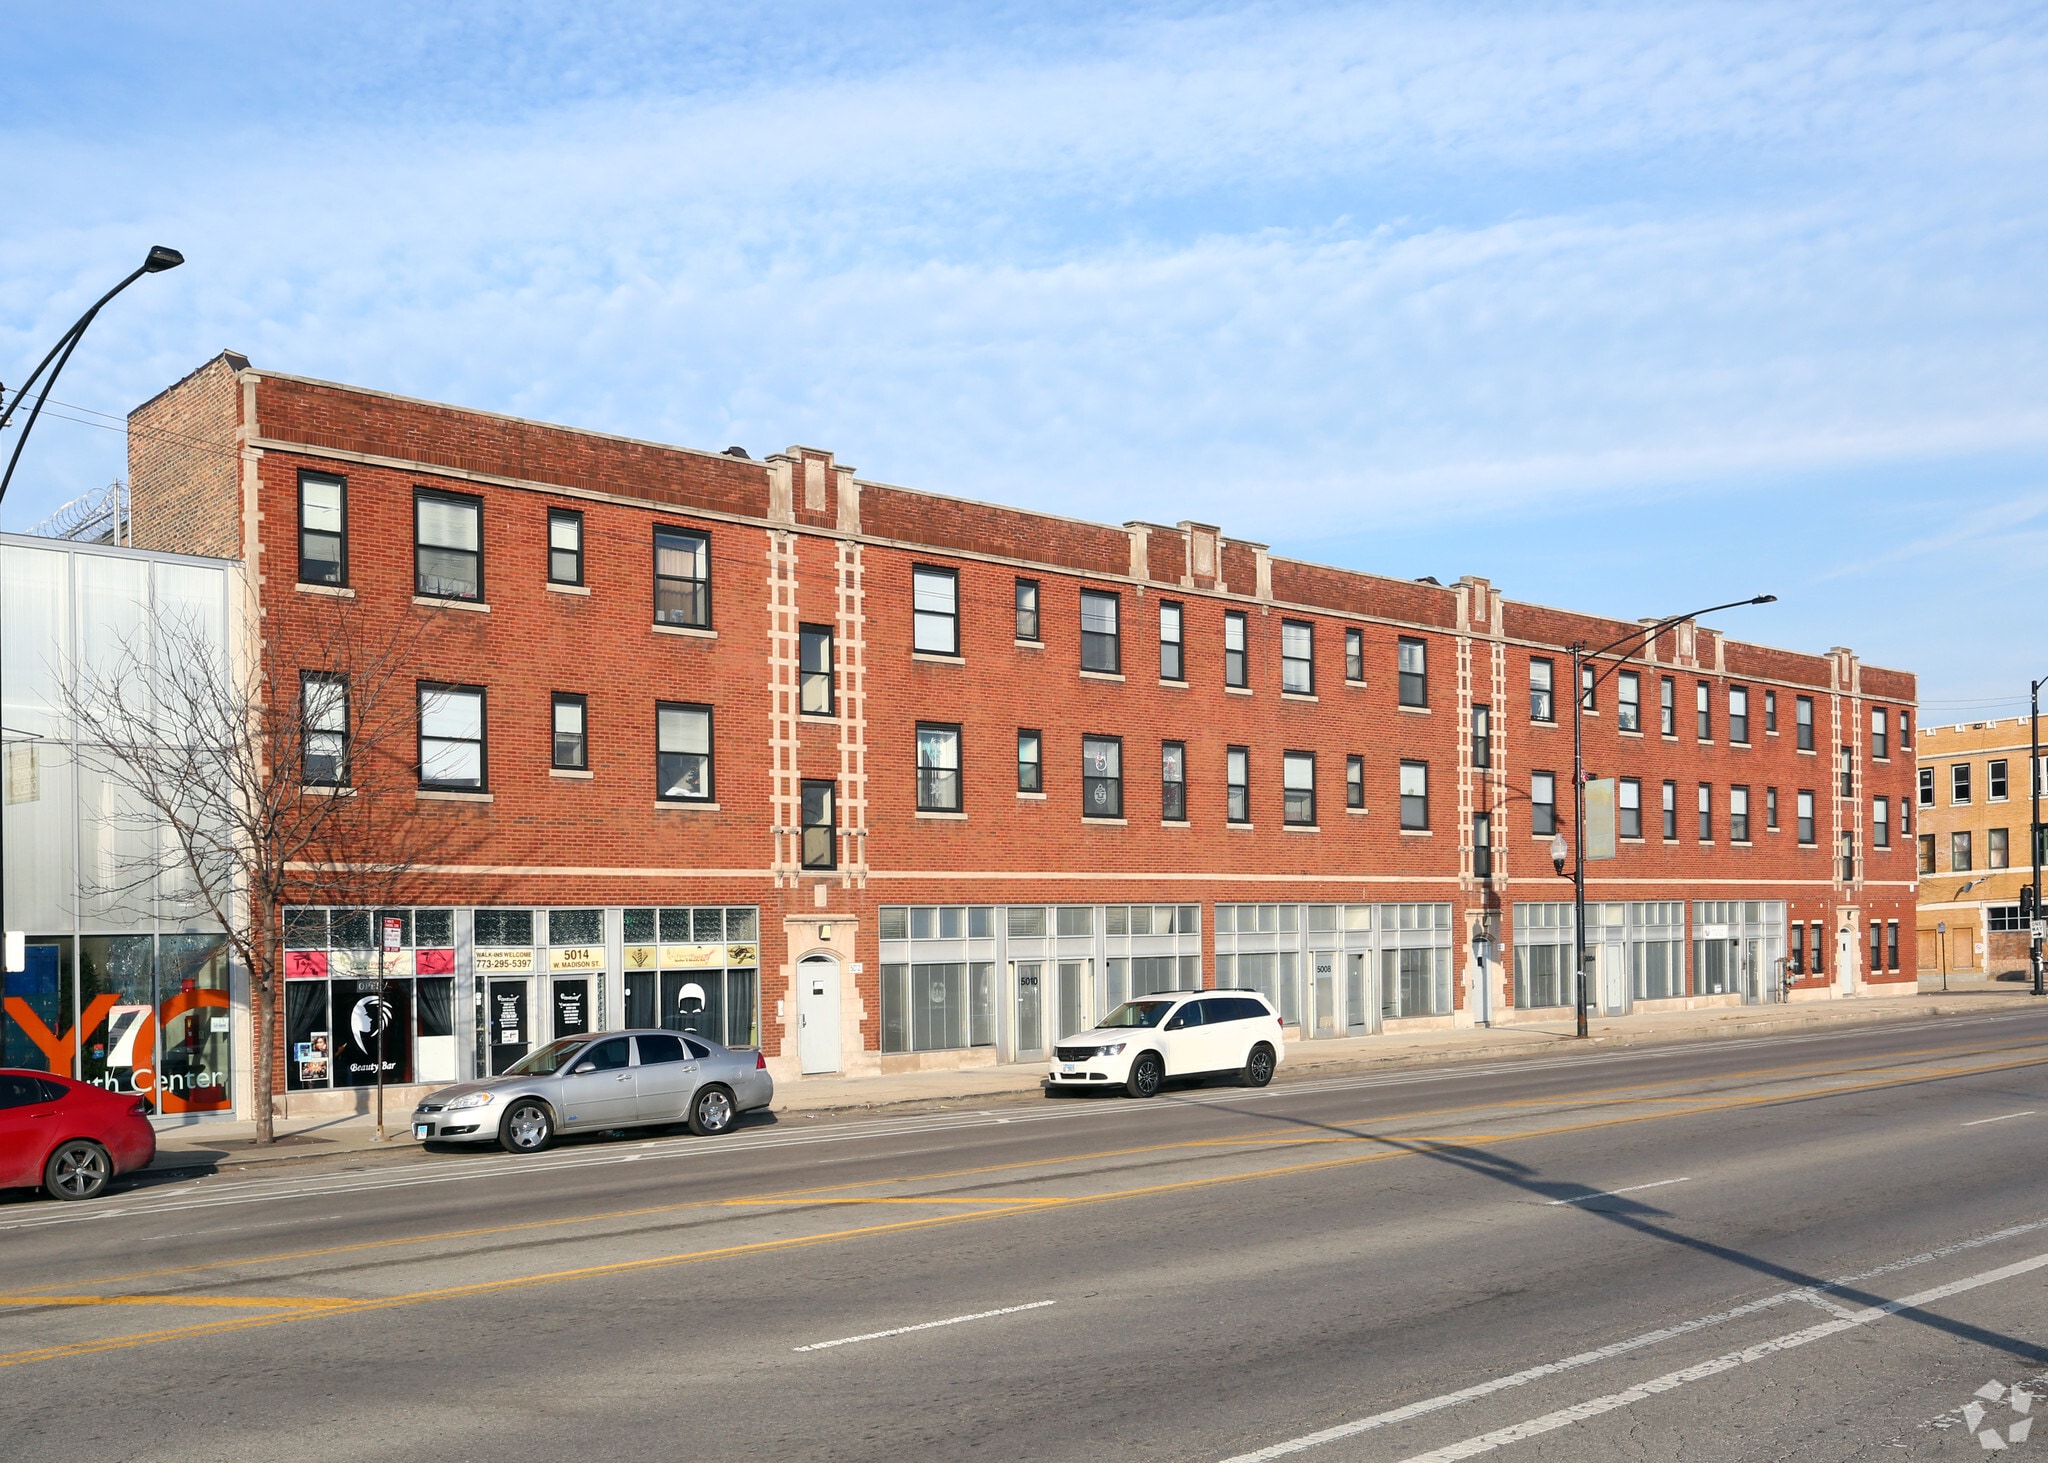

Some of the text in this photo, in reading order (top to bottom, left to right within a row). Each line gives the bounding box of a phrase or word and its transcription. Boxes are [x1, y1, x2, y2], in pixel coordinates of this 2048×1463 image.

[564, 949, 589, 960] 5014
[476, 959, 532, 969] 773-295-5397
[1316, 965, 1332, 973] 5008
[1020, 976, 1038, 986] 5010
[350, 1061, 397, 1074] Beauty Bar
[131, 1068, 223, 1093] Center
